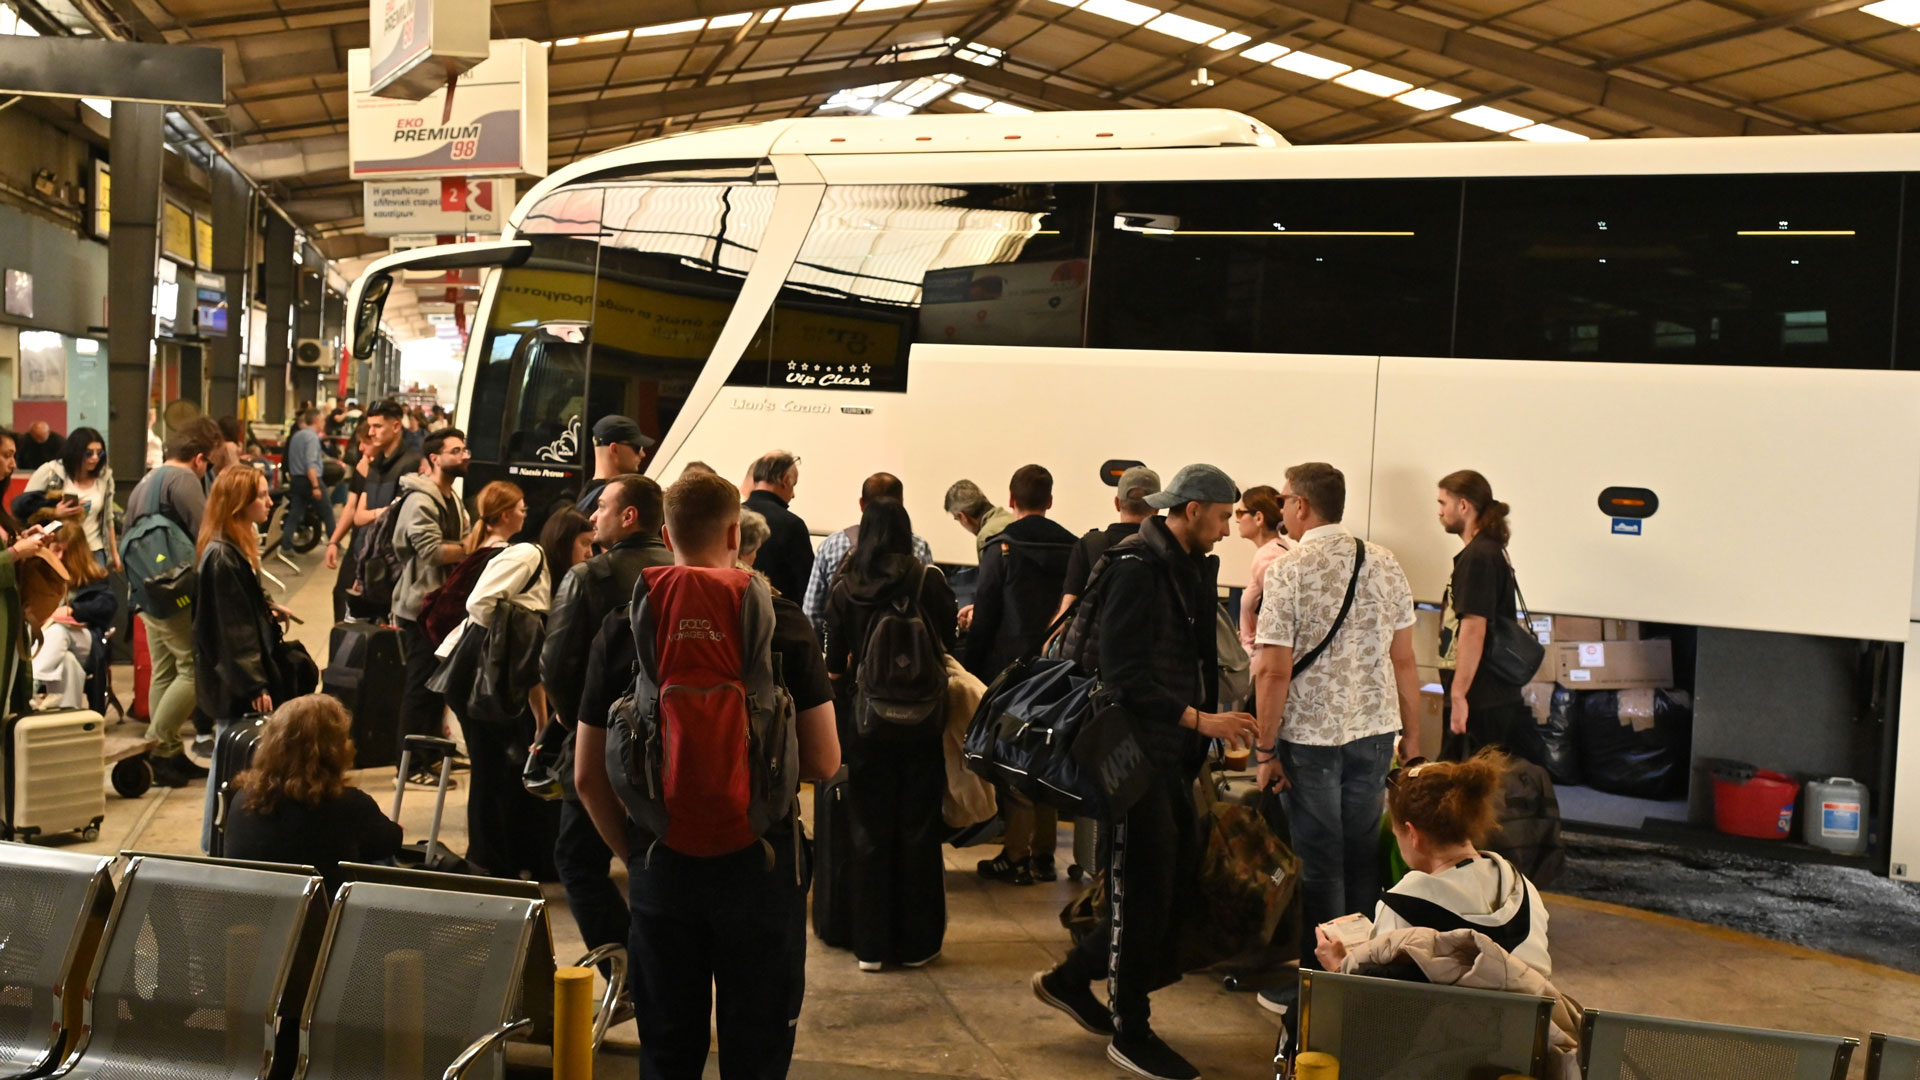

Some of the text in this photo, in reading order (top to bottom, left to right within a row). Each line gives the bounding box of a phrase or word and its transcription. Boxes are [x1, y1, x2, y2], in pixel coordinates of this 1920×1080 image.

[397, 118, 424, 129] EKO
[394, 126, 479, 142] PREMIUM
[452, 140, 476, 158] 98
[449, 188, 459, 203] 2
[785, 372, 871, 386] Vip Class
[730, 398, 832, 414] Lion's Coach
[679, 618, 711, 631] POLO
[668, 630, 709, 642] VOYAGER
